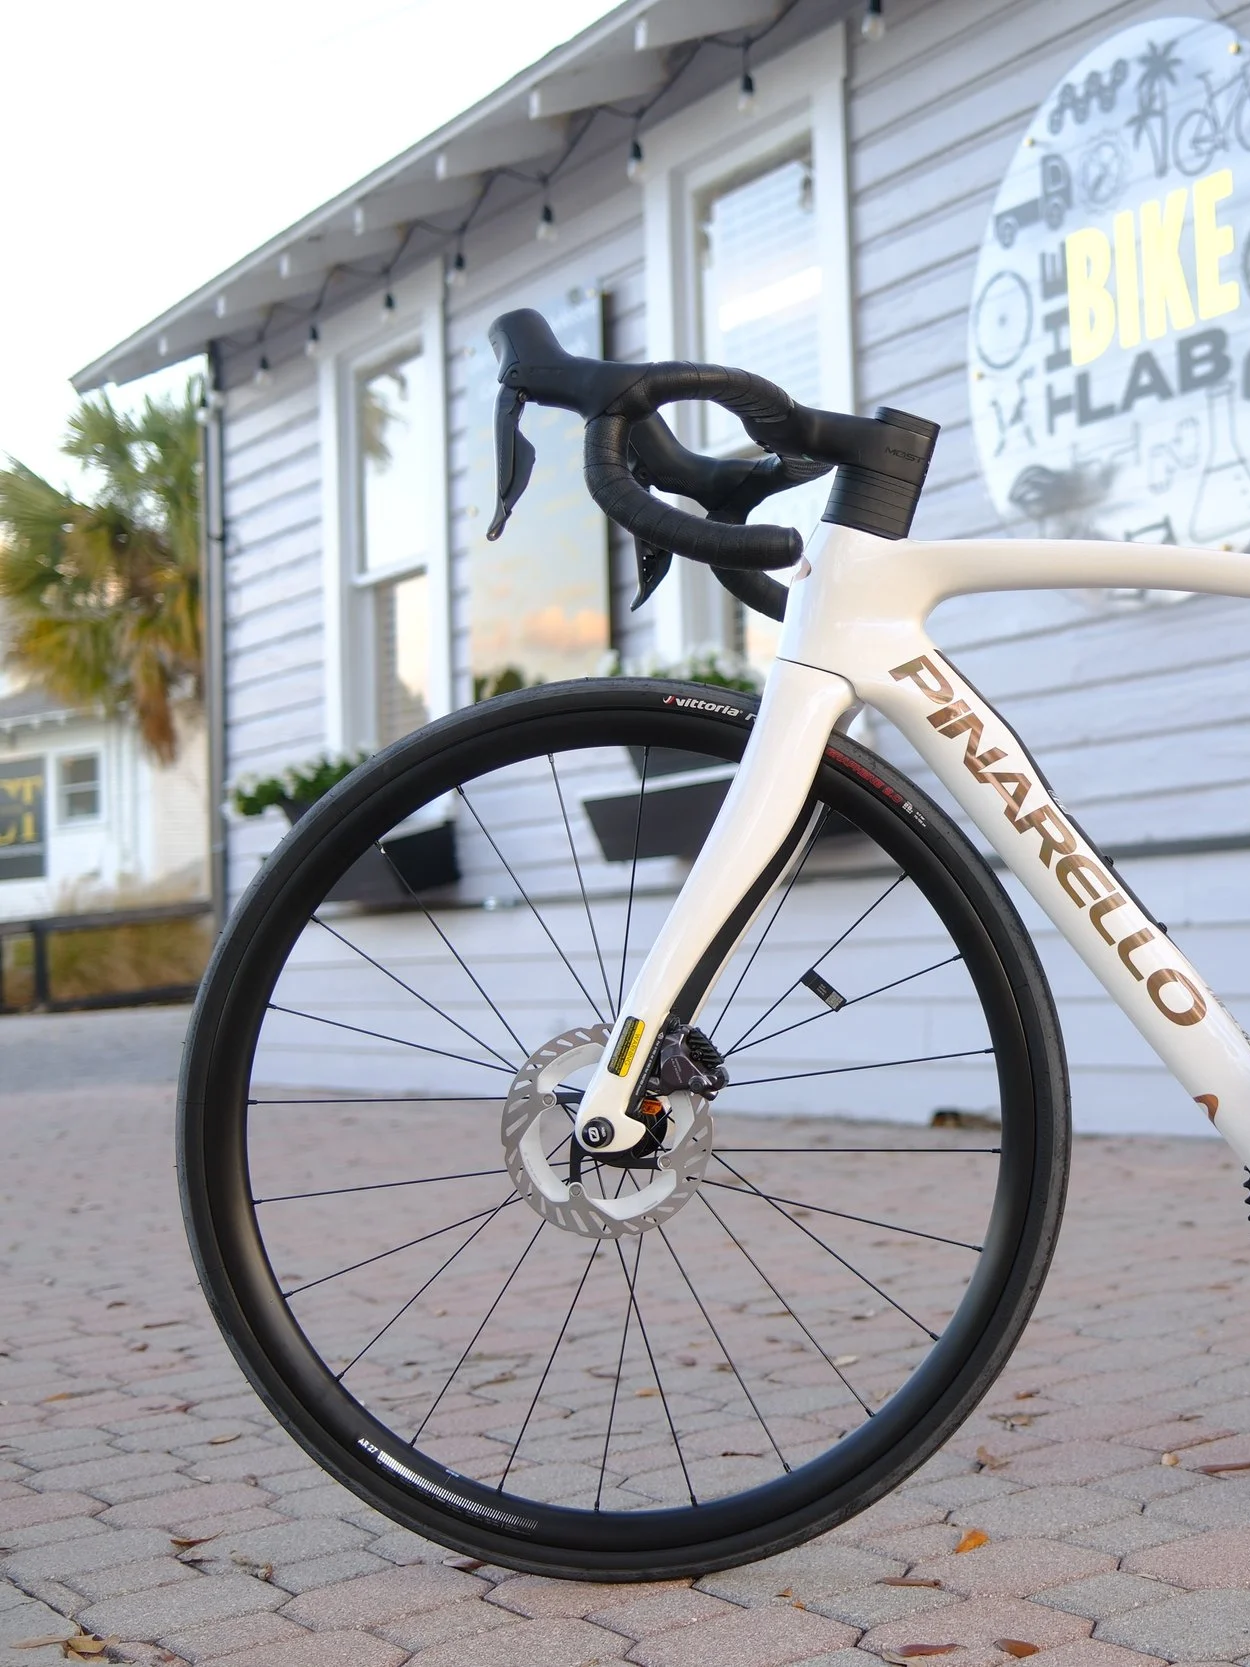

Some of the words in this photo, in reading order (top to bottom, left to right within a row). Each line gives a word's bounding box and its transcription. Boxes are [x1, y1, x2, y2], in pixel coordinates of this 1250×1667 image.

[1064, 168, 1240, 367] BIKE
[1075, 327, 1233, 428] LAB
[675, 697, 740, 717] vittoria
[888, 654, 1207, 1027] PINARELLO
[357, 1438, 369, 1449] AR
[367, 1442, 378, 1453] 27
